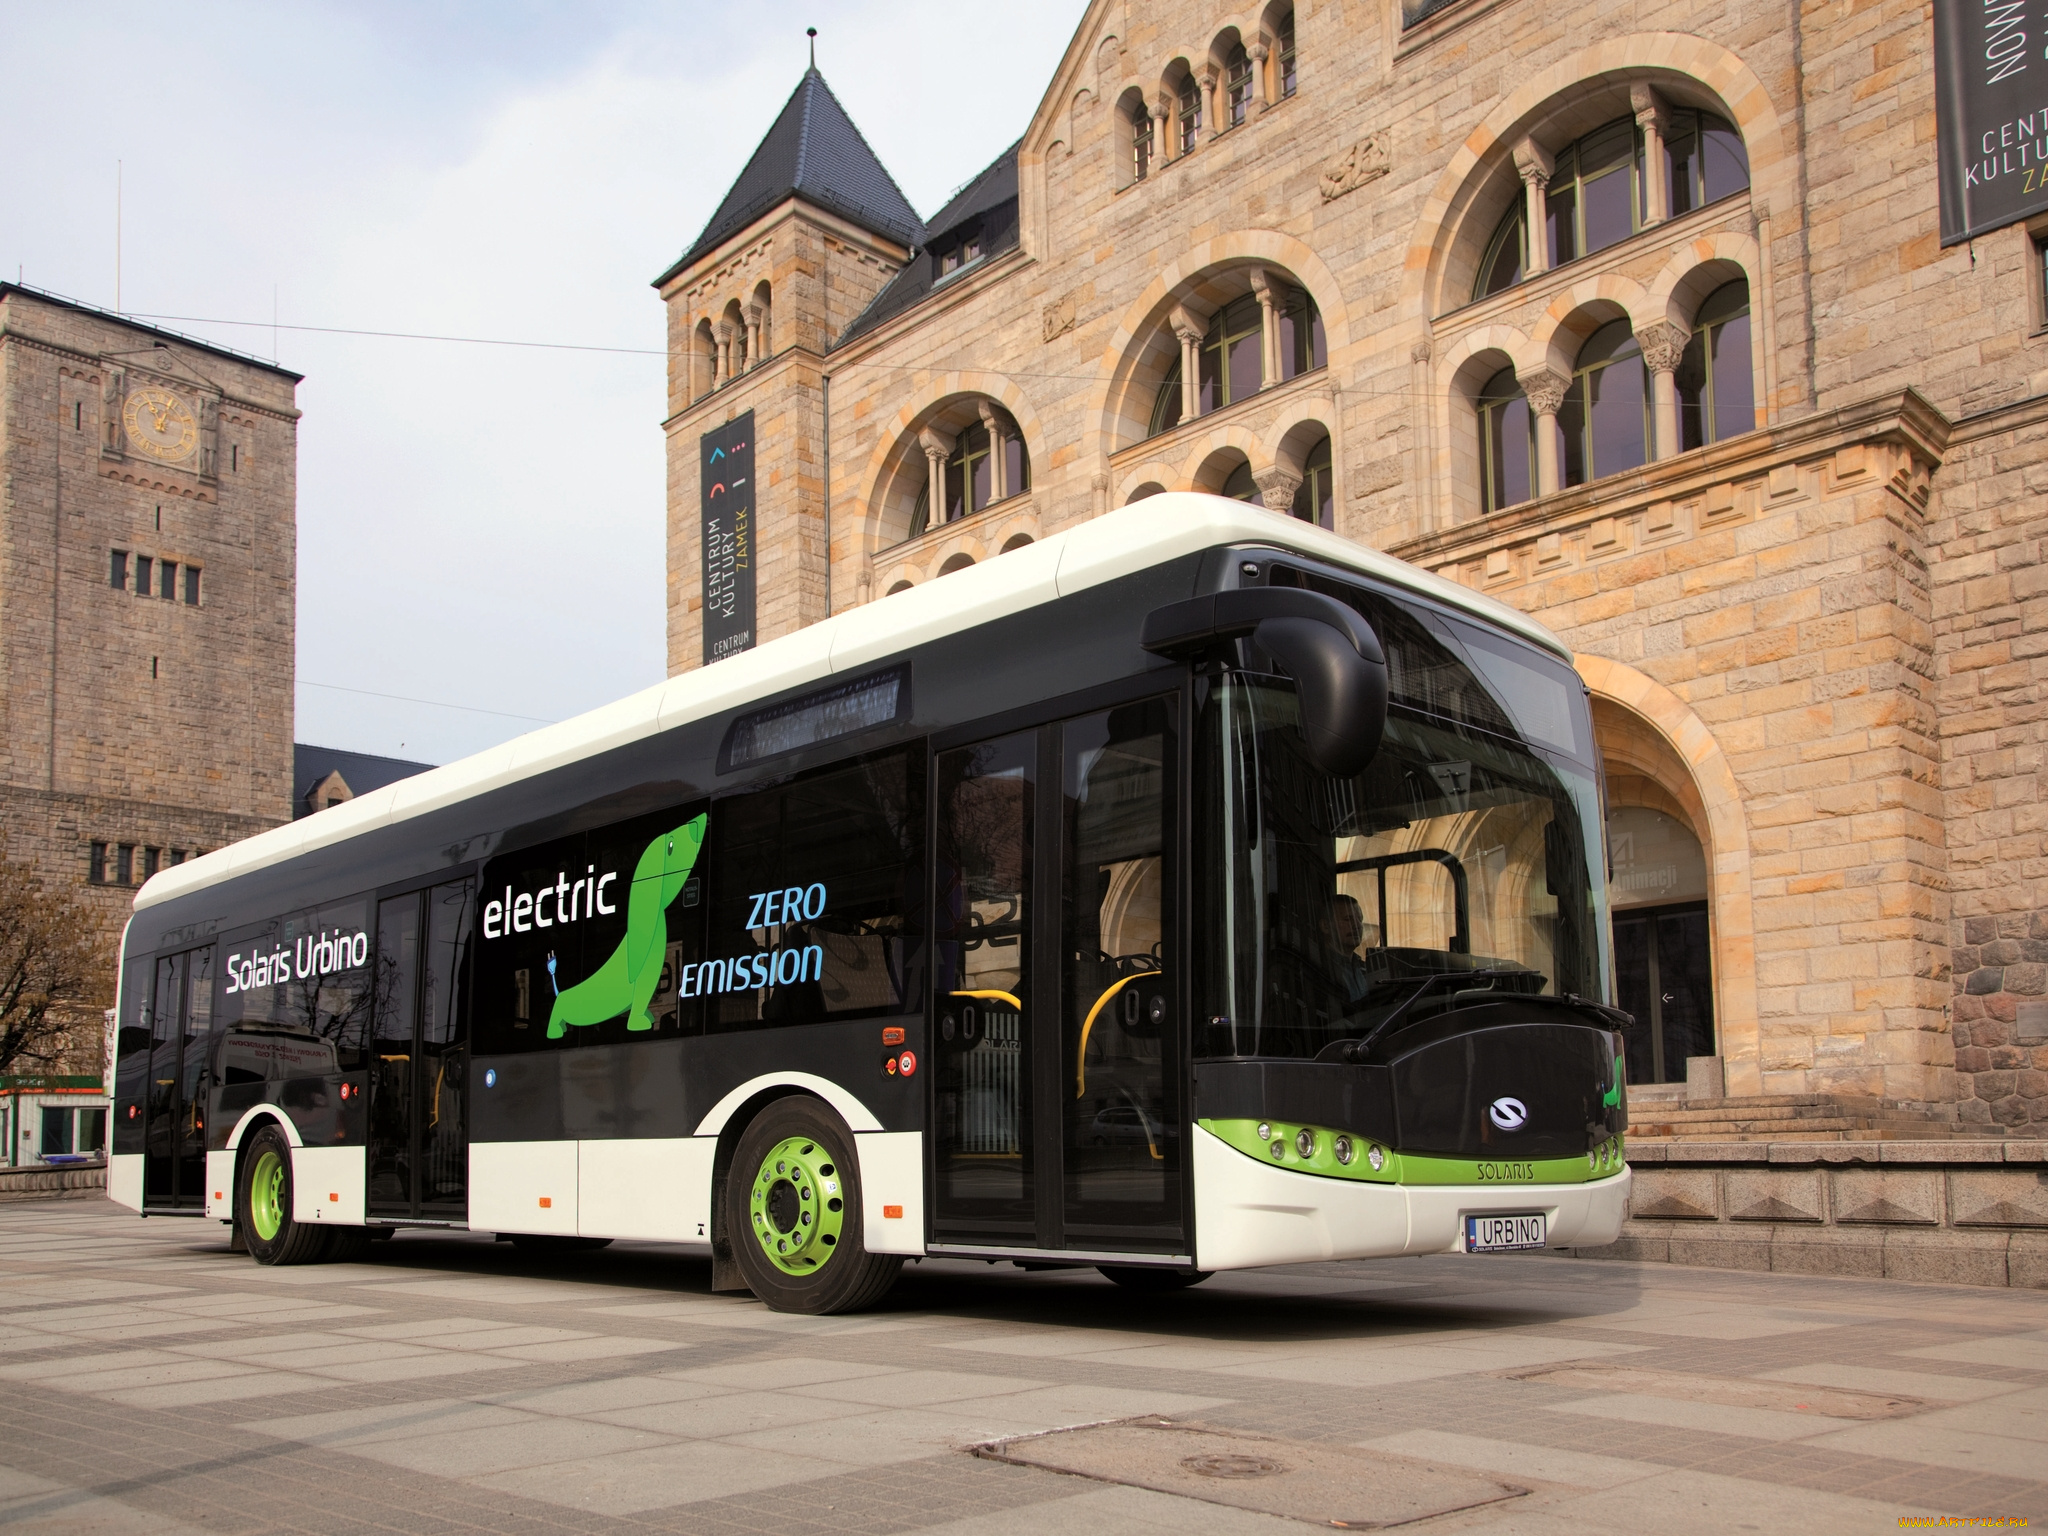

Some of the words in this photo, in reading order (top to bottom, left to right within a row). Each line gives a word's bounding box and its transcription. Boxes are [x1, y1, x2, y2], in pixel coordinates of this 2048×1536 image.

[1984, 0, 2027, 85] NOW
[709, 518, 720, 610] CENTRUM
[736, 507, 747, 572] ZAMEK
[722, 532, 735, 618] KULTURY
[713, 630, 749, 655] CENTRUM
[483, 864, 617, 939] electric
[745, 882, 827, 930] ZERO
[225, 943, 291, 995] Solaris
[295, 928, 368, 979] Urbino
[1477, 1163, 1534, 1180] SOLARIS
[1482, 1218, 1540, 1244] URBINO
